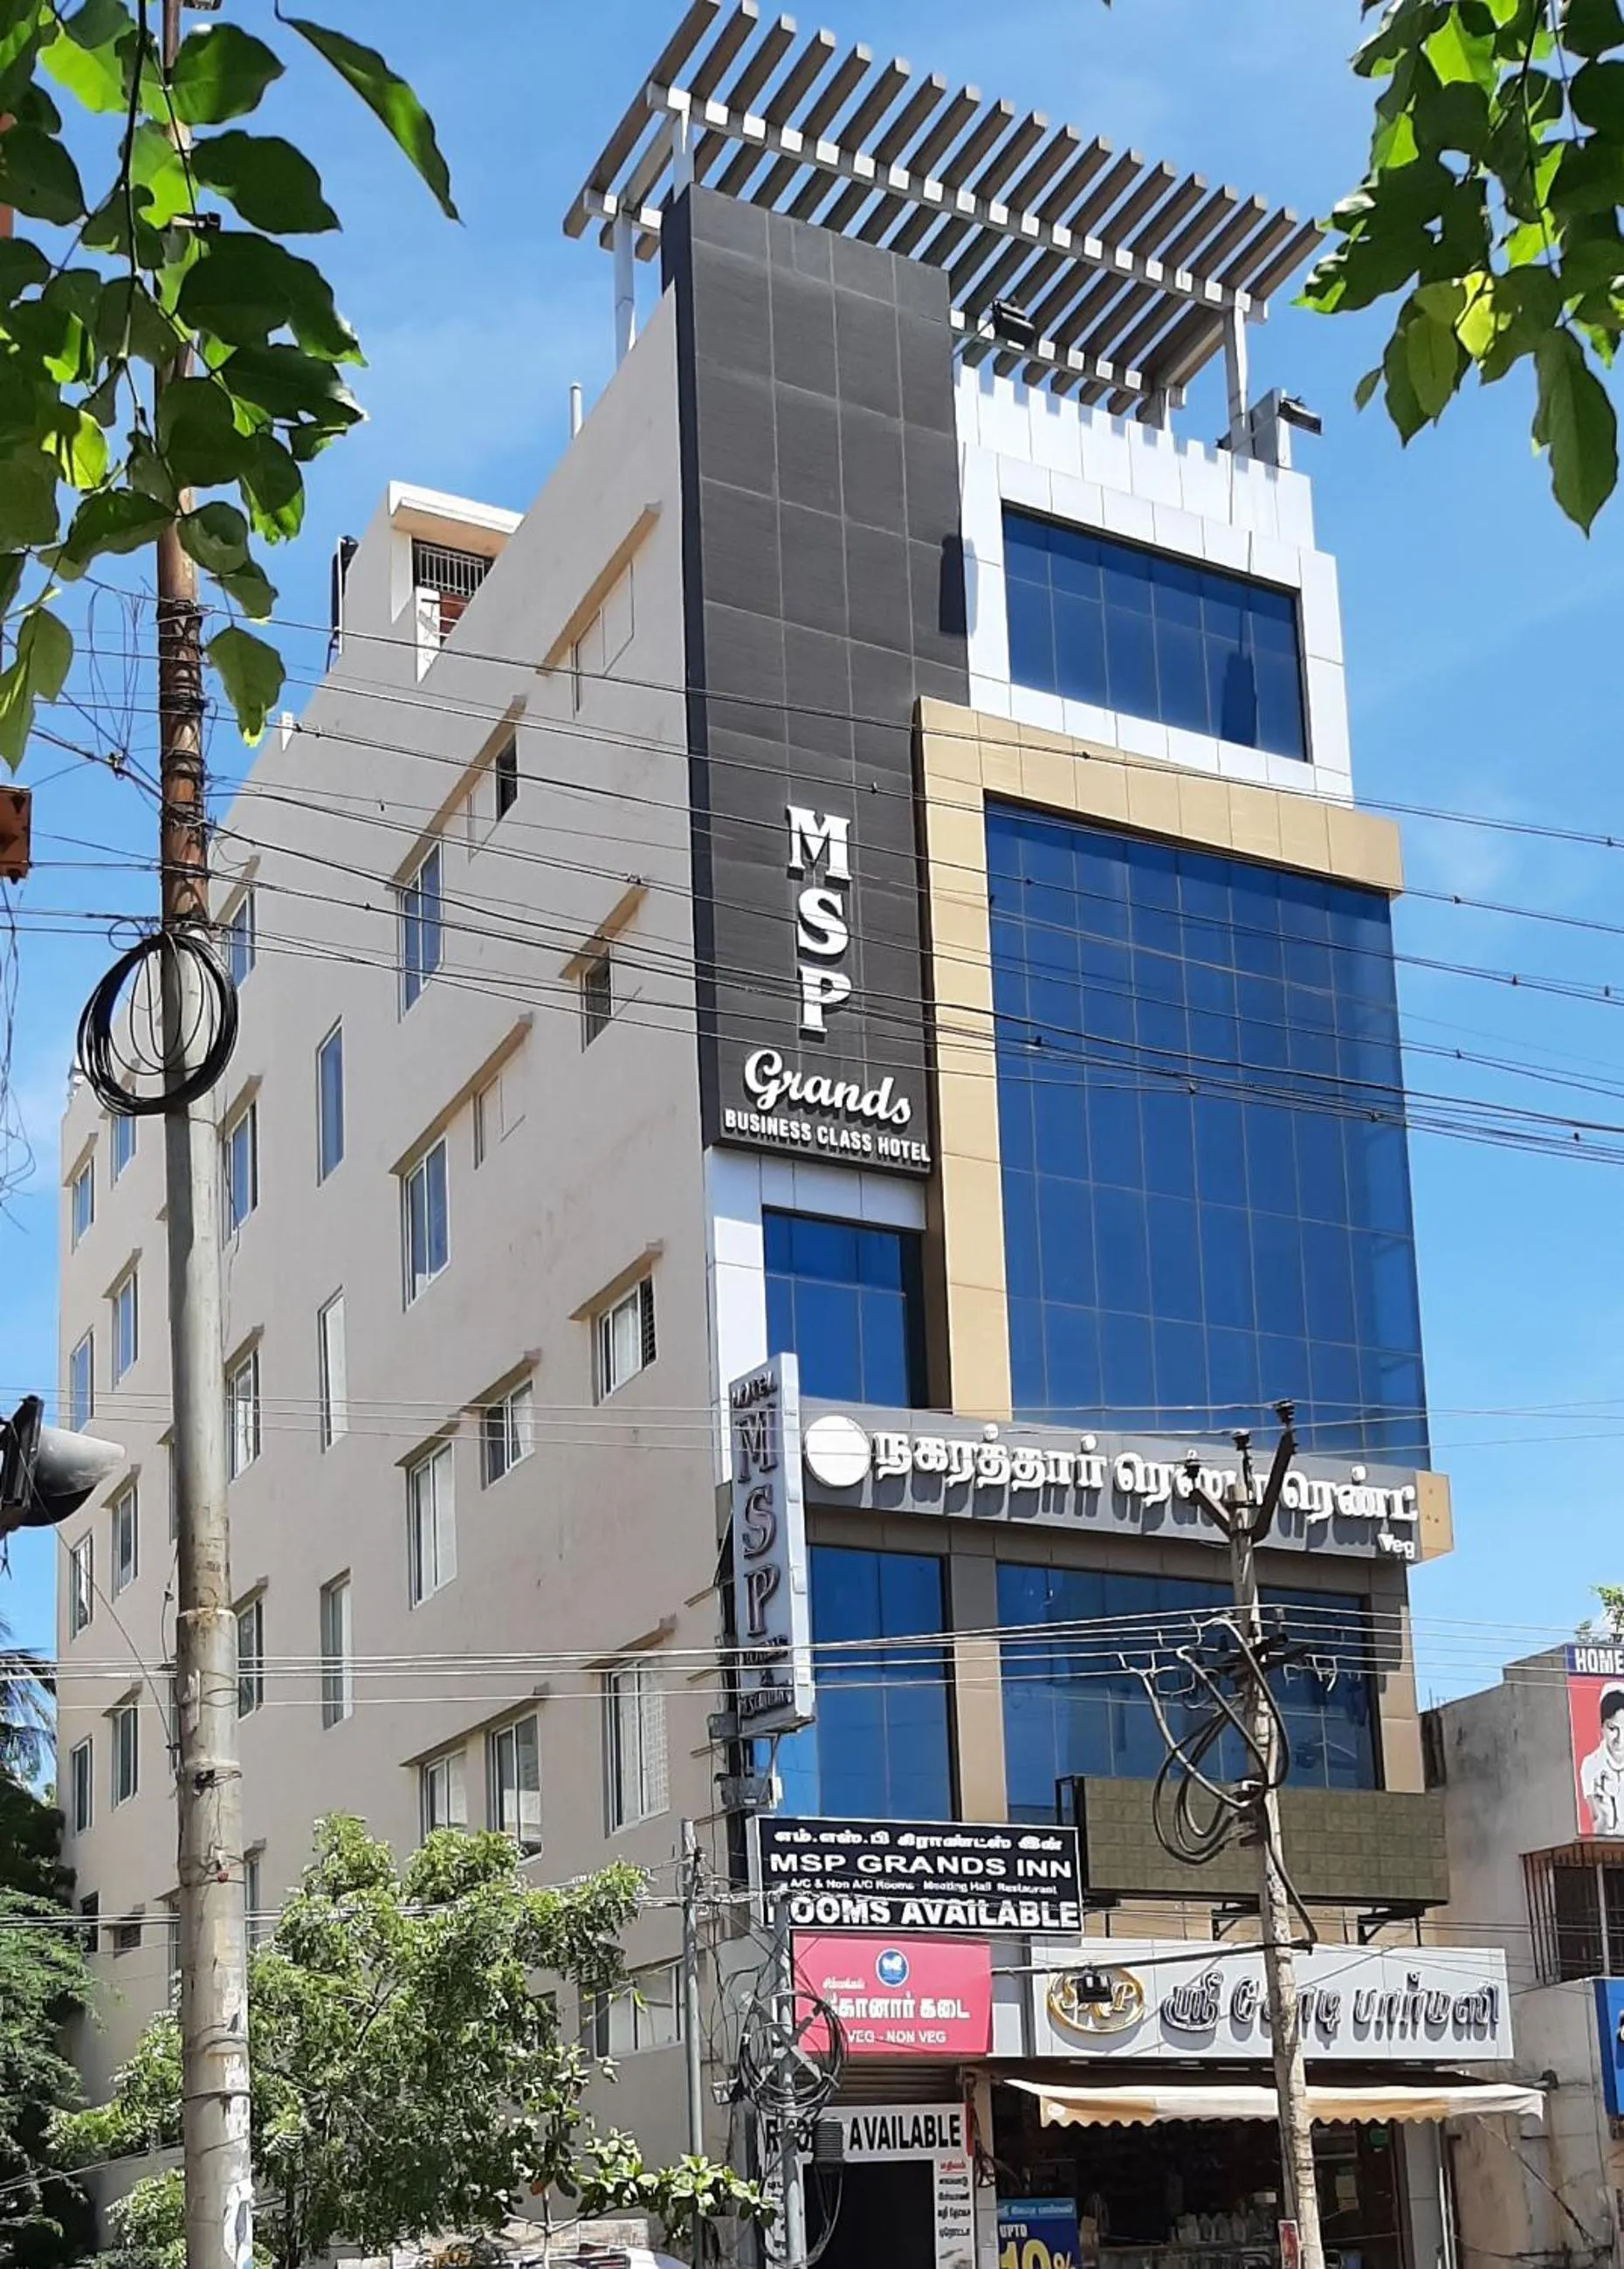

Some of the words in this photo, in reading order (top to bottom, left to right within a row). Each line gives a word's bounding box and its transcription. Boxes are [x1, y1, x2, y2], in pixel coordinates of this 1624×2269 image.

[745, 1050, 912, 1125] Grands
[726, 1108, 812, 1142] BUSINESS
[817, 1125, 872, 1152] CLASS
[878, 1132, 932, 1162] HOTEL
[874, 1423, 1106, 1491] நகரத்தார்
[1378, 1534, 1415, 1560] Veg
[1574, 1648, 1623, 1674] HOME
[770, 1853, 846, 1872] MSP
[857, 1854, 1007, 1876] GRANDS
[1017, 1859, 1071, 1878] INN
[790, 1879, 812, 1889] A/C
[814, 1879, 823, 1889] &
[826, 1879, 850, 1890] Non
[852, 1879, 873, 1890] A/C
[876, 1880, 915, 1891] Rooms
[923, 1880, 967, 1893] Meeting
[970, 1881, 992, 1892] Hall
[900, 1900, 1079, 1928] AVAILABLE
[920, 1997, 971, 2019] கடை
[848, 2030, 875, 2043] VEG
[886, 2030, 915, 2043] NON
[919, 2030, 946, 2044] VEG
[849, 2114, 961, 2151] AVAILABLE
[1000, 2224, 1028, 2238] UPTO
